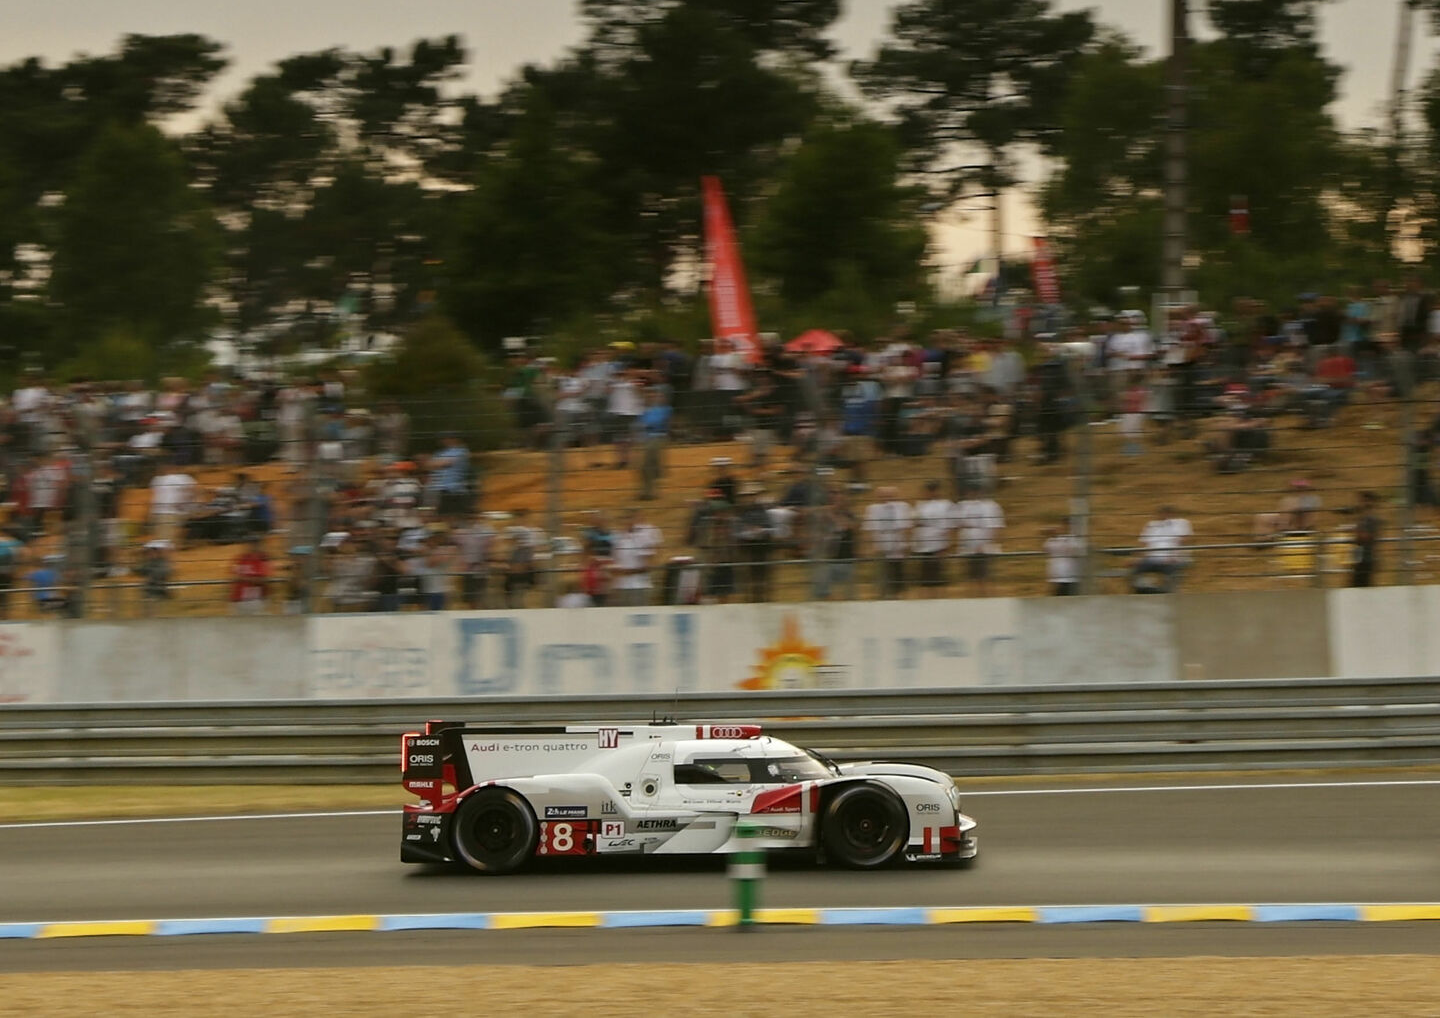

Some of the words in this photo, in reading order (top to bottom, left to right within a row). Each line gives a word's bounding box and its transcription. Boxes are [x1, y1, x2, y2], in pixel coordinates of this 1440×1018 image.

[599, 729, 618, 748] HY
[471, 743, 500, 751] Audi
[503, 743, 540, 751] e-tron
[543, 743, 588, 753] quattro
[409, 754, 434, 763] ORIS
[651, 752, 671, 760] ORIS
[916, 803, 941, 811] ORIS
[637, 819, 677, 829] AETHRA
[606, 824, 622, 836] P1
[552, 822, 574, 851] 8
